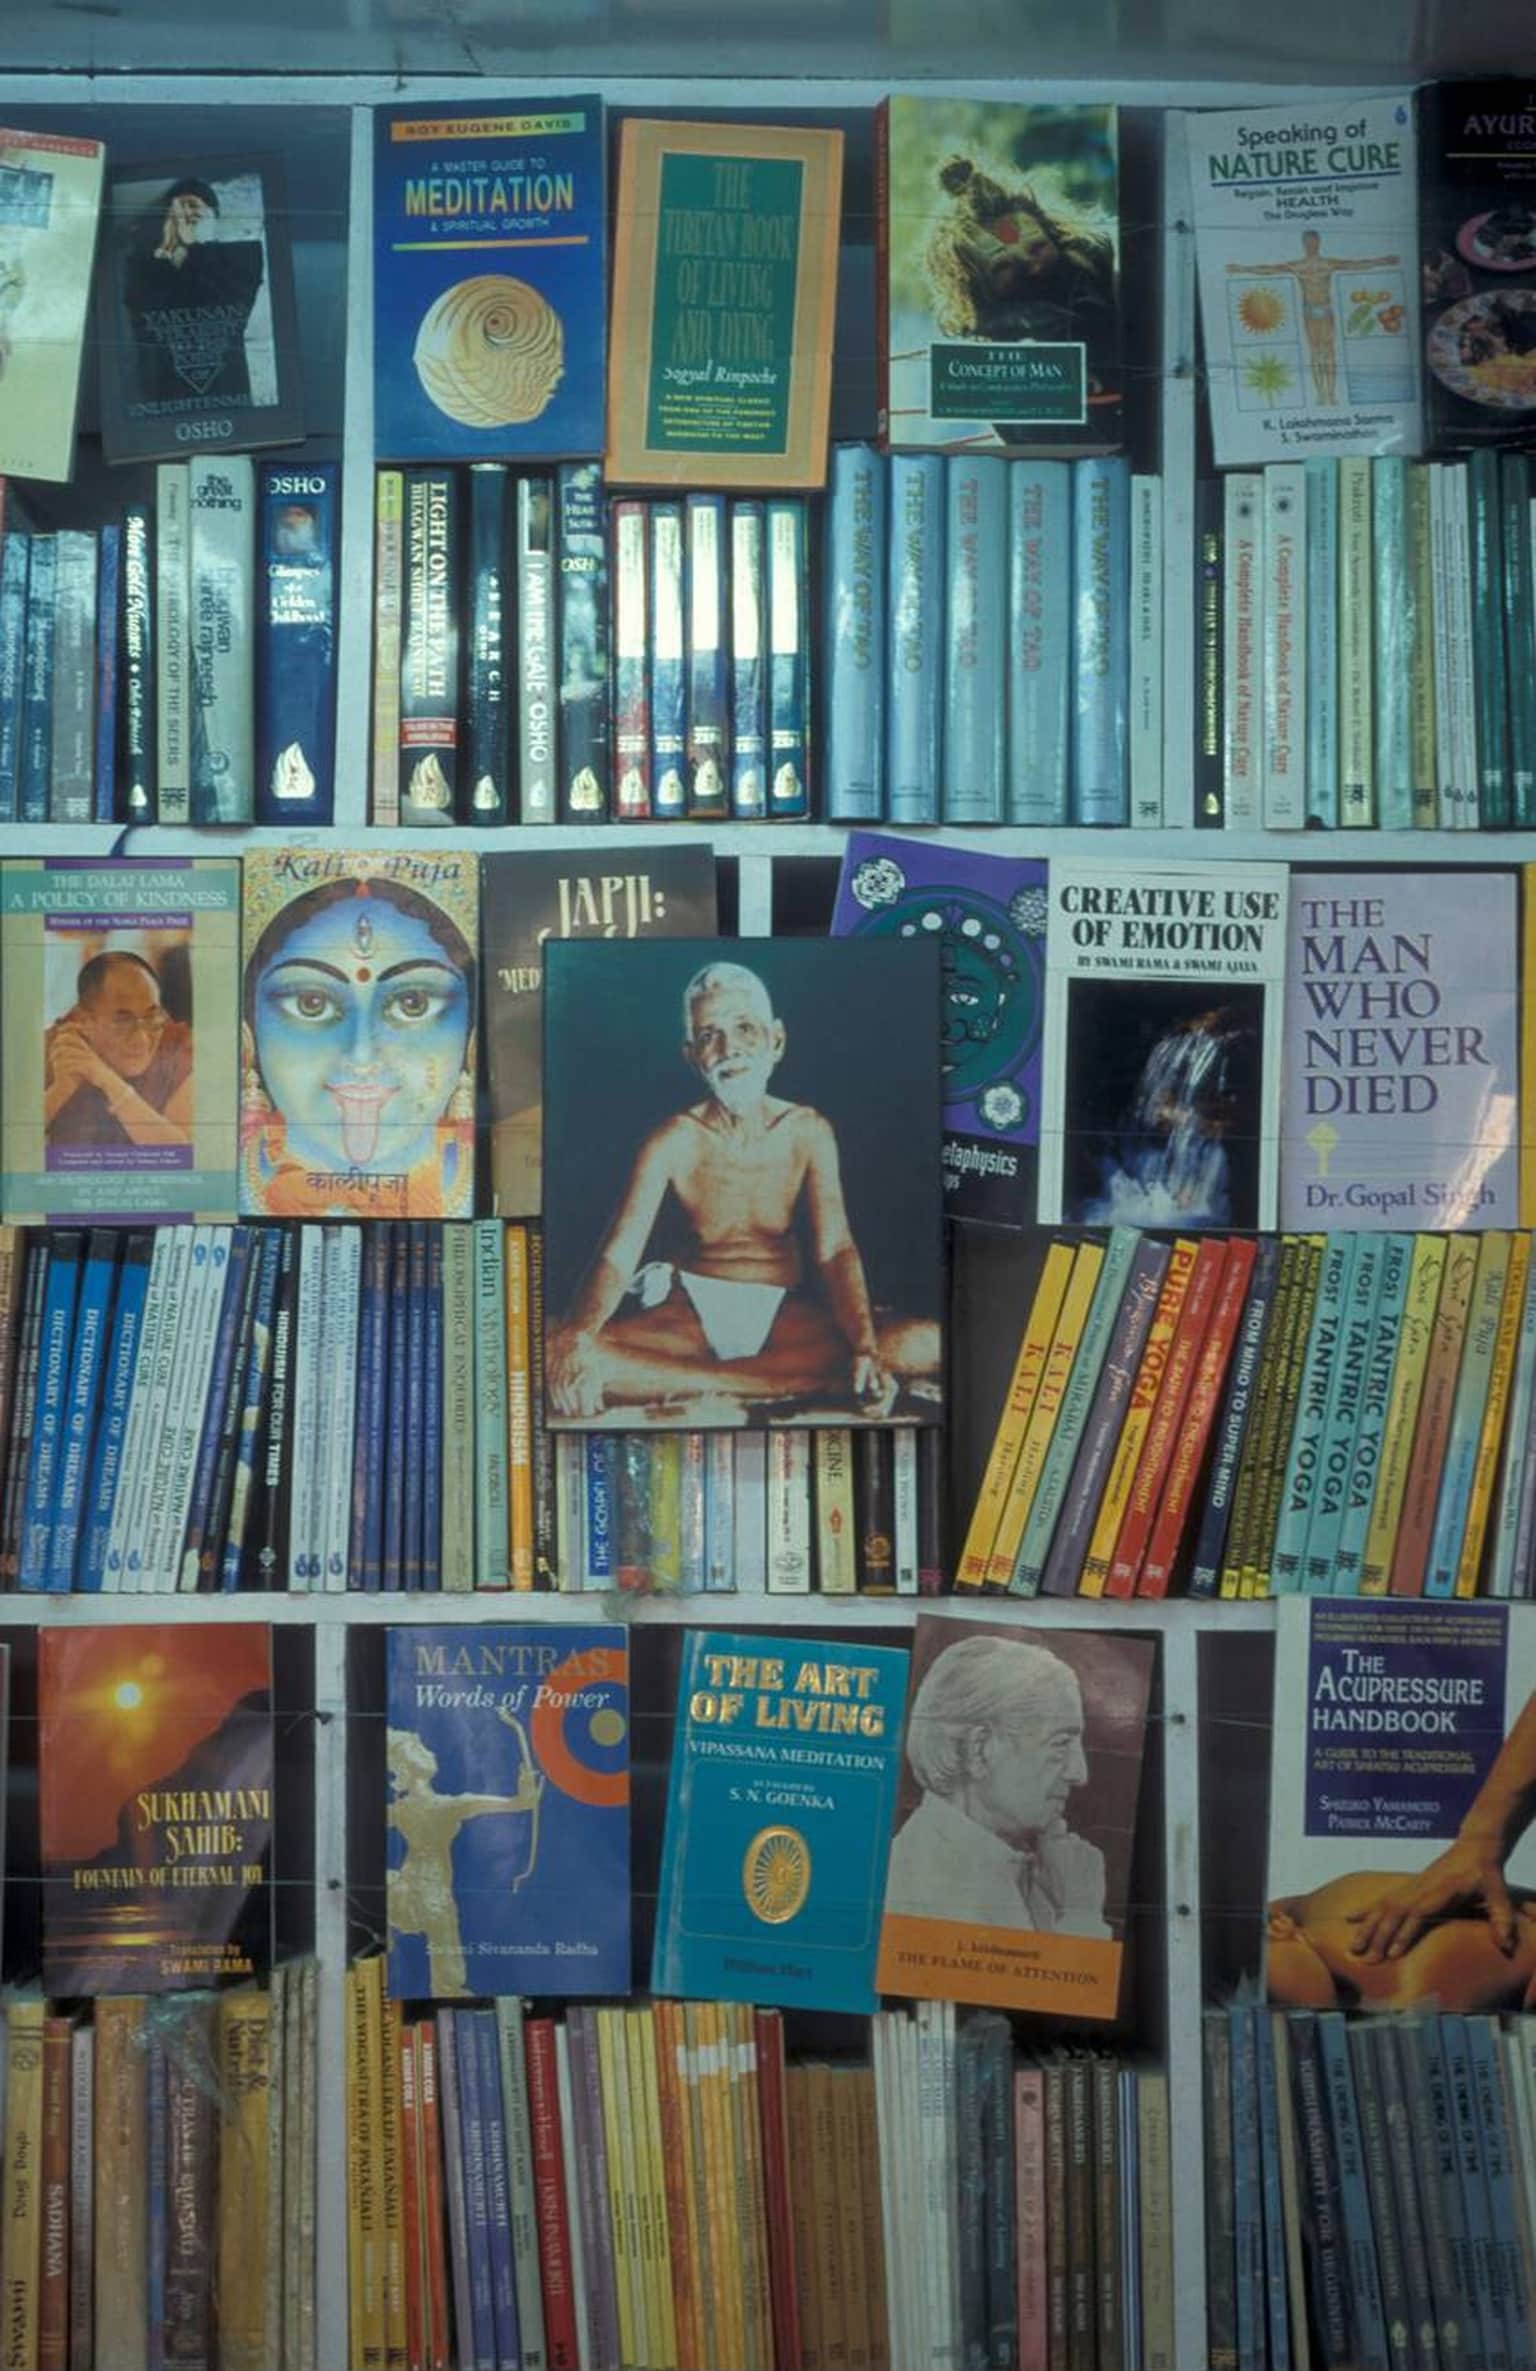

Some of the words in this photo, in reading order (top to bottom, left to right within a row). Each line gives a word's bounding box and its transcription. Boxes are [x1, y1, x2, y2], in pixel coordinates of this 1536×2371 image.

[446, 121, 517, 135] EUGENE
[520, 118, 571, 131] DAVIS
[1237, 123, 1338, 150] Speaking
[1345, 118, 1367, 139] of
[1208, 149, 1318, 180] NATURE
[1327, 142, 1401, 172] CURE
[405, 173, 574, 217] MEDITATION
[1276, 194, 1339, 209] HEALTH
[715, 366, 777, 389] Rinpoche
[175, 420, 233, 440] OSHO
[427, 481, 448, 549] LIGHT
[853, 470, 874, 523] THE
[1023, 484, 1043, 531] THE
[1090, 478, 1111, 532] THE
[853, 527, 873, 579] WAY
[1023, 537, 1043, 584] WAY
[1238, 540, 1253, 551] A
[1278, 534, 1292, 545] A
[427, 554, 448, 586] ON
[527, 572, 547, 605] AM
[427, 589, 448, 633] THE
[1023, 588, 1043, 620] OF
[1023, 626, 1043, 673] TAO
[1236, 617, 1253, 681] Handbook
[1276, 613, 1293, 677] Handbook
[167, 662, 181, 680] OF
[427, 637, 448, 697] PATH
[527, 646, 547, 693] GATE
[167, 686, 181, 713] THE
[528, 700, 550, 763] OSHO
[139, 874, 186, 888] LAMA
[273, 849, 349, 881] Kali
[383, 855, 462, 881] Puja
[11, 893, 25, 909] A
[32, 892, 100, 908] POLICY
[103, 891, 129, 907] OF
[135, 890, 228, 907] KINDNESS
[1060, 885, 1216, 918] CREATIVE
[1224, 890, 1281, 920] USE
[1301, 899, 1385, 928] THE
[1072, 918, 1112, 947] OF
[1121, 921, 1264, 952] EMOTION
[1301, 934, 1433, 976] MAN
[1095, 955, 1133, 969] SWAMI
[1136, 957, 1169, 970] RAMA
[1184, 959, 1221, 972] SWAMI
[1304, 979, 1441, 1021] WHO
[1304, 1026, 1491, 1068] NEVER
[1304, 1073, 1438, 1116] DIED
[942, 1140, 1018, 1176] etaphysics
[1306, 1184, 1344, 1208] Dr.
[1345, 1183, 1417, 1214] Gopal
[1422, 1183, 1496, 1210] Sih
[479, 1228, 501, 1298] Indian
[1323, 1248, 1344, 1305] FROST
[1354, 1252, 1375, 1308] FROST
[1383, 1245, 1404, 1299] FROST
[1152, 1246, 1195, 1334] PURE
[1244, 1298, 1263, 1343] FROM
[43, 1309, 66, 1407] DICTIONARY
[74, 1307, 99, 1407] DICTIONARY
[110, 1311, 136, 1409] DICTIONARY
[273, 1310, 290, 1379] HINDUISM
[479, 1305, 502, 1417] Mythology
[1236, 1346, 1254, 1386] MIND
[1366, 1312, 1399, 1419] TANTRIC
[1130, 1334, 1169, 1414] YOGA
[1304, 1315, 1340, 1422] TANTRIC
[1336, 1318, 1370, 1425] TANTRIC
[271, 1382, 287, 1409] FOR
[1231, 1390, 1245, 1411] TO
[42, 1412, 57, 1434] OF
[71, 1412, 89, 1434] OF
[107, 1415, 125, 1439] OF
[510, 1369, 528, 1466] HINDUISM
[1219, 1413, 1240, 1463] SUPER
[35, 1441, 55, 1510] DREAMS
[60, 1441, 85, 1510] DREAMS
[96, 1444, 120, 1511] DREAMS
[265, 1443, 282, 1487] TIMES
[1210, 1466, 1229, 1507] MIND
[1290, 1432, 1320, 1513] YOGA
[1319, 1434, 1352, 1516] YOGA
[1350, 1429, 1381, 1510] YOGA
[415, 1645, 609, 1677] MANTRAS
[705, 1654, 785, 1691] THE
[793, 1662, 880, 1698] ART
[1342, 1649, 1385, 1674] THE
[415, 1684, 495, 1708] Words
[500, 1684, 528, 1713] of
[533, 1684, 610, 1708] Power
[1314, 1665, 1484, 1706] ACUPRESSURE
[690, 1691, 744, 1725] OF
[756, 1695, 885, 1738] LIVING
[1312, 1707, 1457, 1734] HANDBOOK
[690, 1740, 777, 1761] VIPASSANA
[781, 1748, 886, 1770] MEDITATION
[136, 1789, 271, 1832] SUKHAMANI
[165, 1825, 244, 1865] SAHIB:
[898, 1951, 928, 1967] THE
[932, 1954, 983, 1974] FLAME
[987, 1960, 1006, 1976] OF
[1013, 1964, 1099, 1986] ATTENTION
[1298, 2059, 1330, 2197] KRISHNAMURTI
[1317, 2203, 1335, 2241] FOR
[46, 2183, 64, 2277] SADHANA
